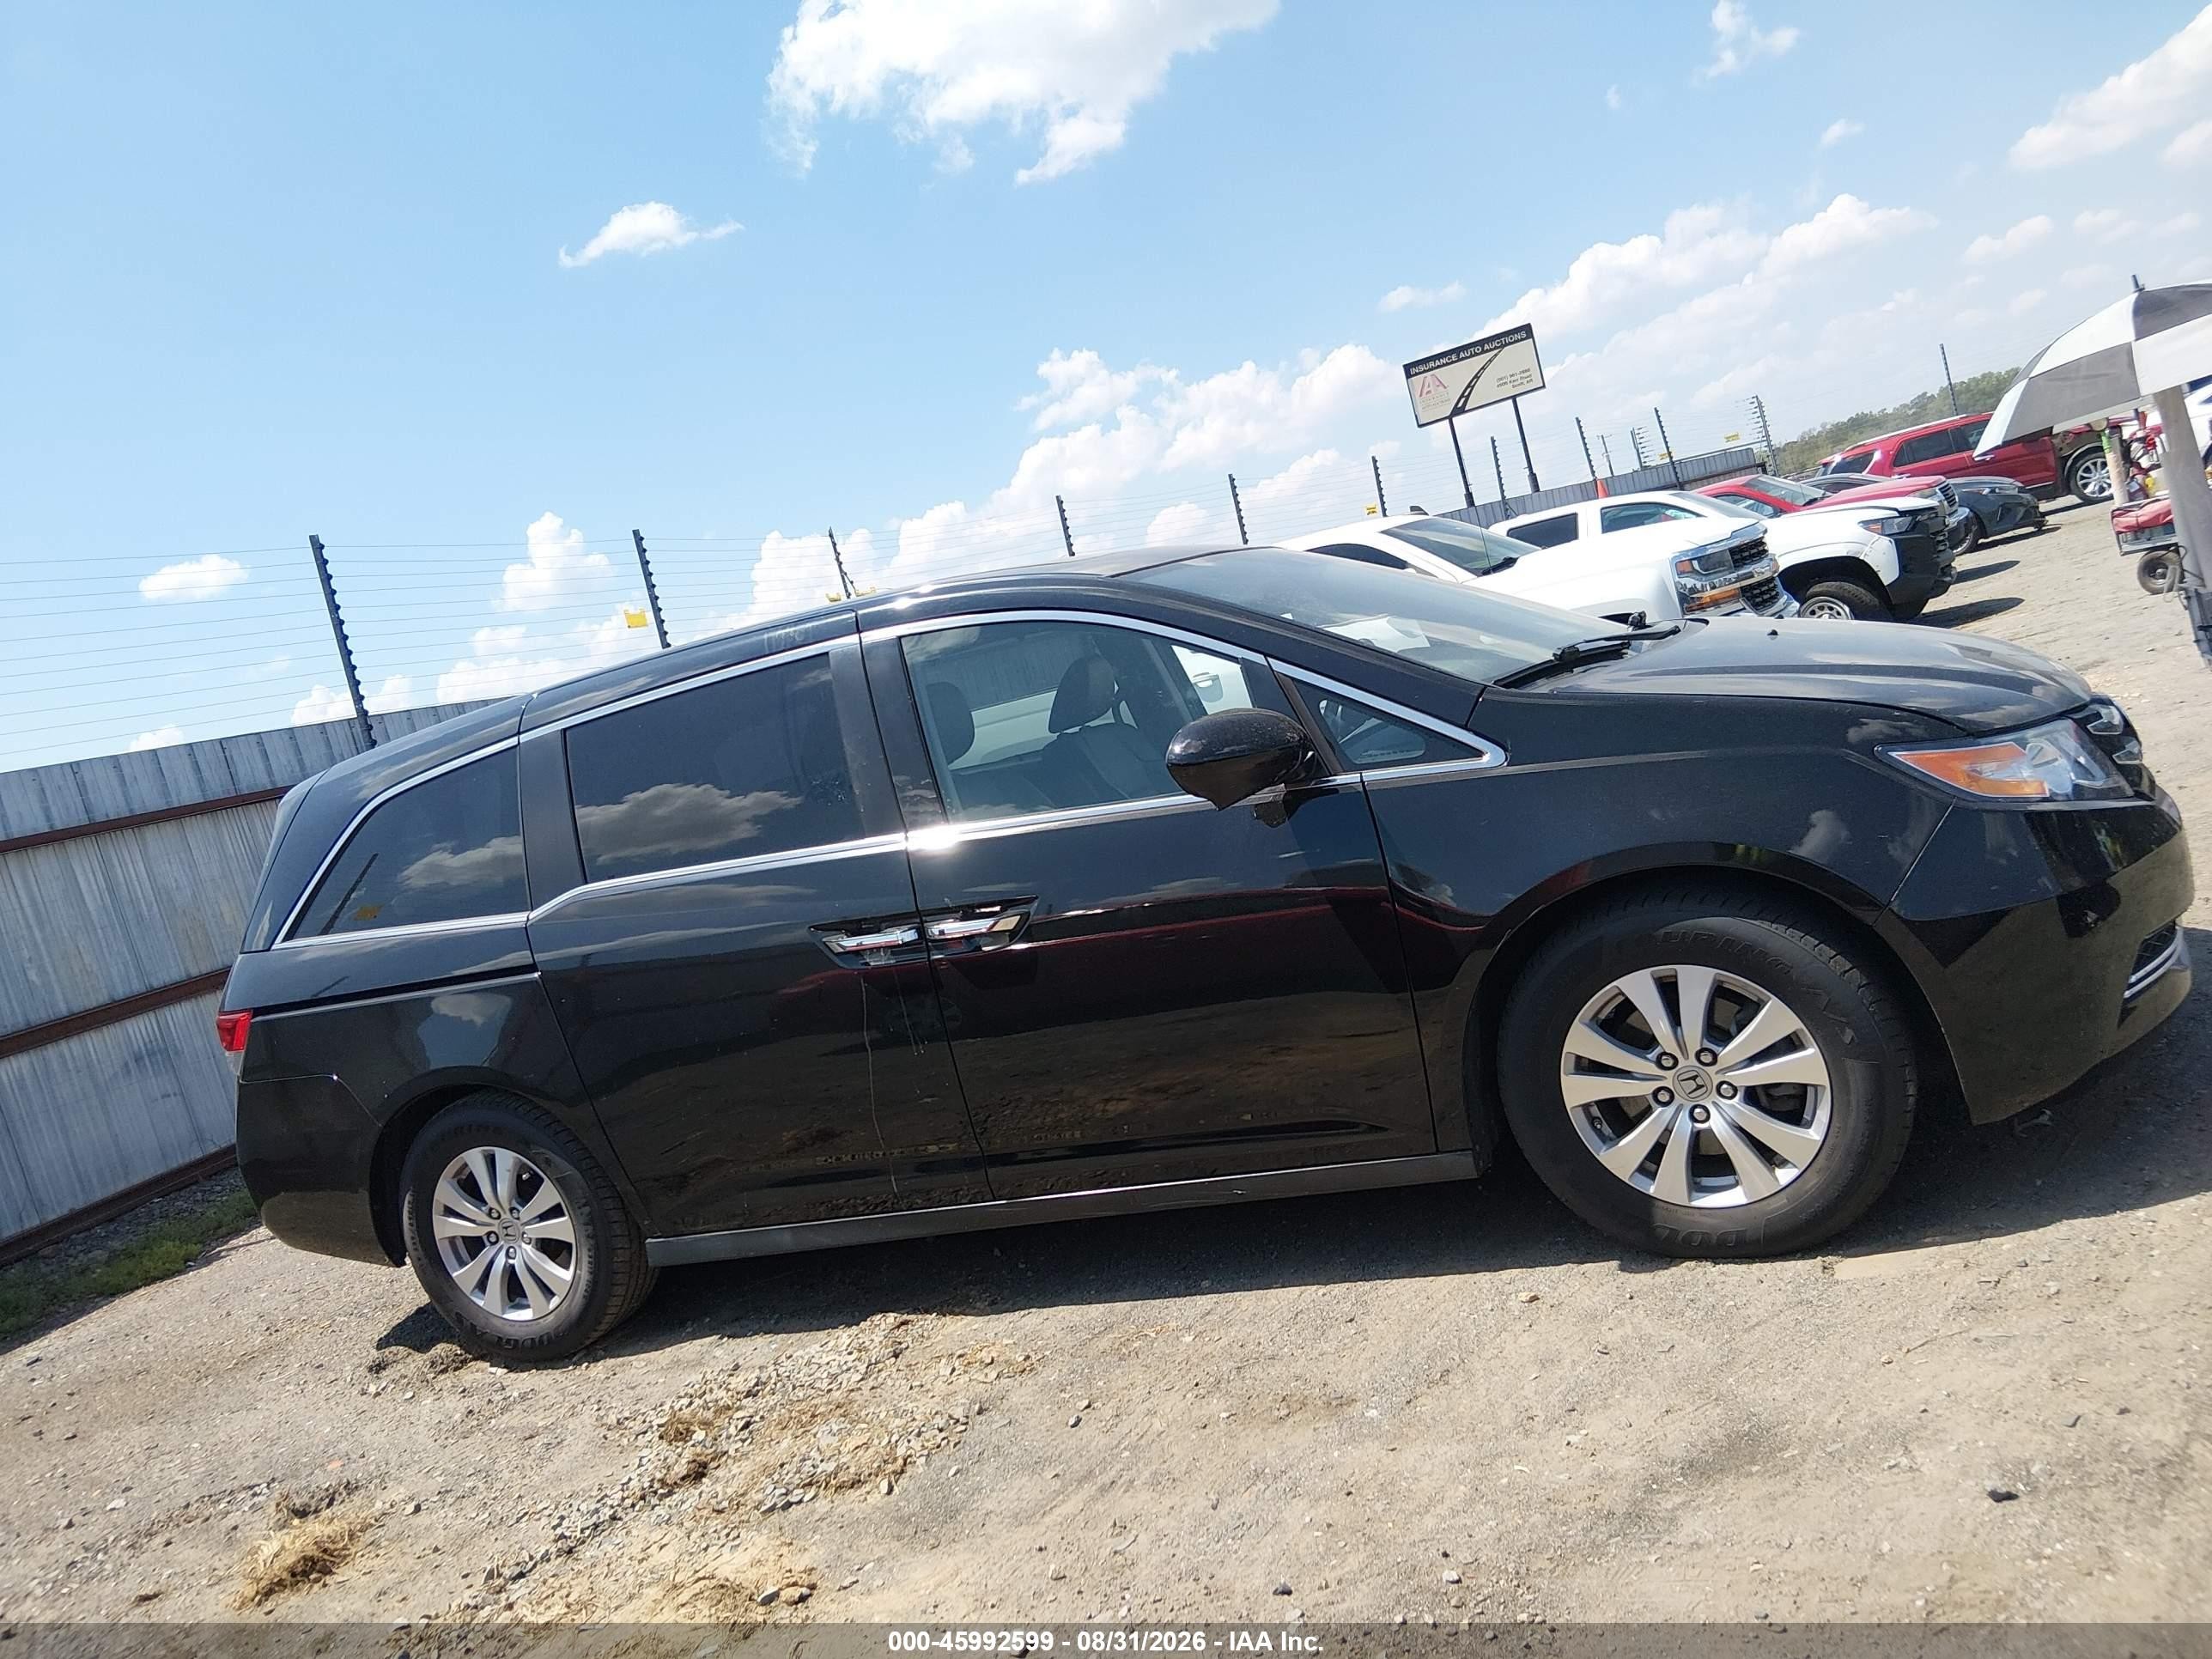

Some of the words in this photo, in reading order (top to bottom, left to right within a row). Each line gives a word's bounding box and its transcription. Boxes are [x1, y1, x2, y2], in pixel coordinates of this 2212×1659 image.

[1410, 354, 1458, 375] INSURANCE
[1460, 345, 1482, 359] AUTO
[1484, 331, 1527, 350] AUCTIONS
